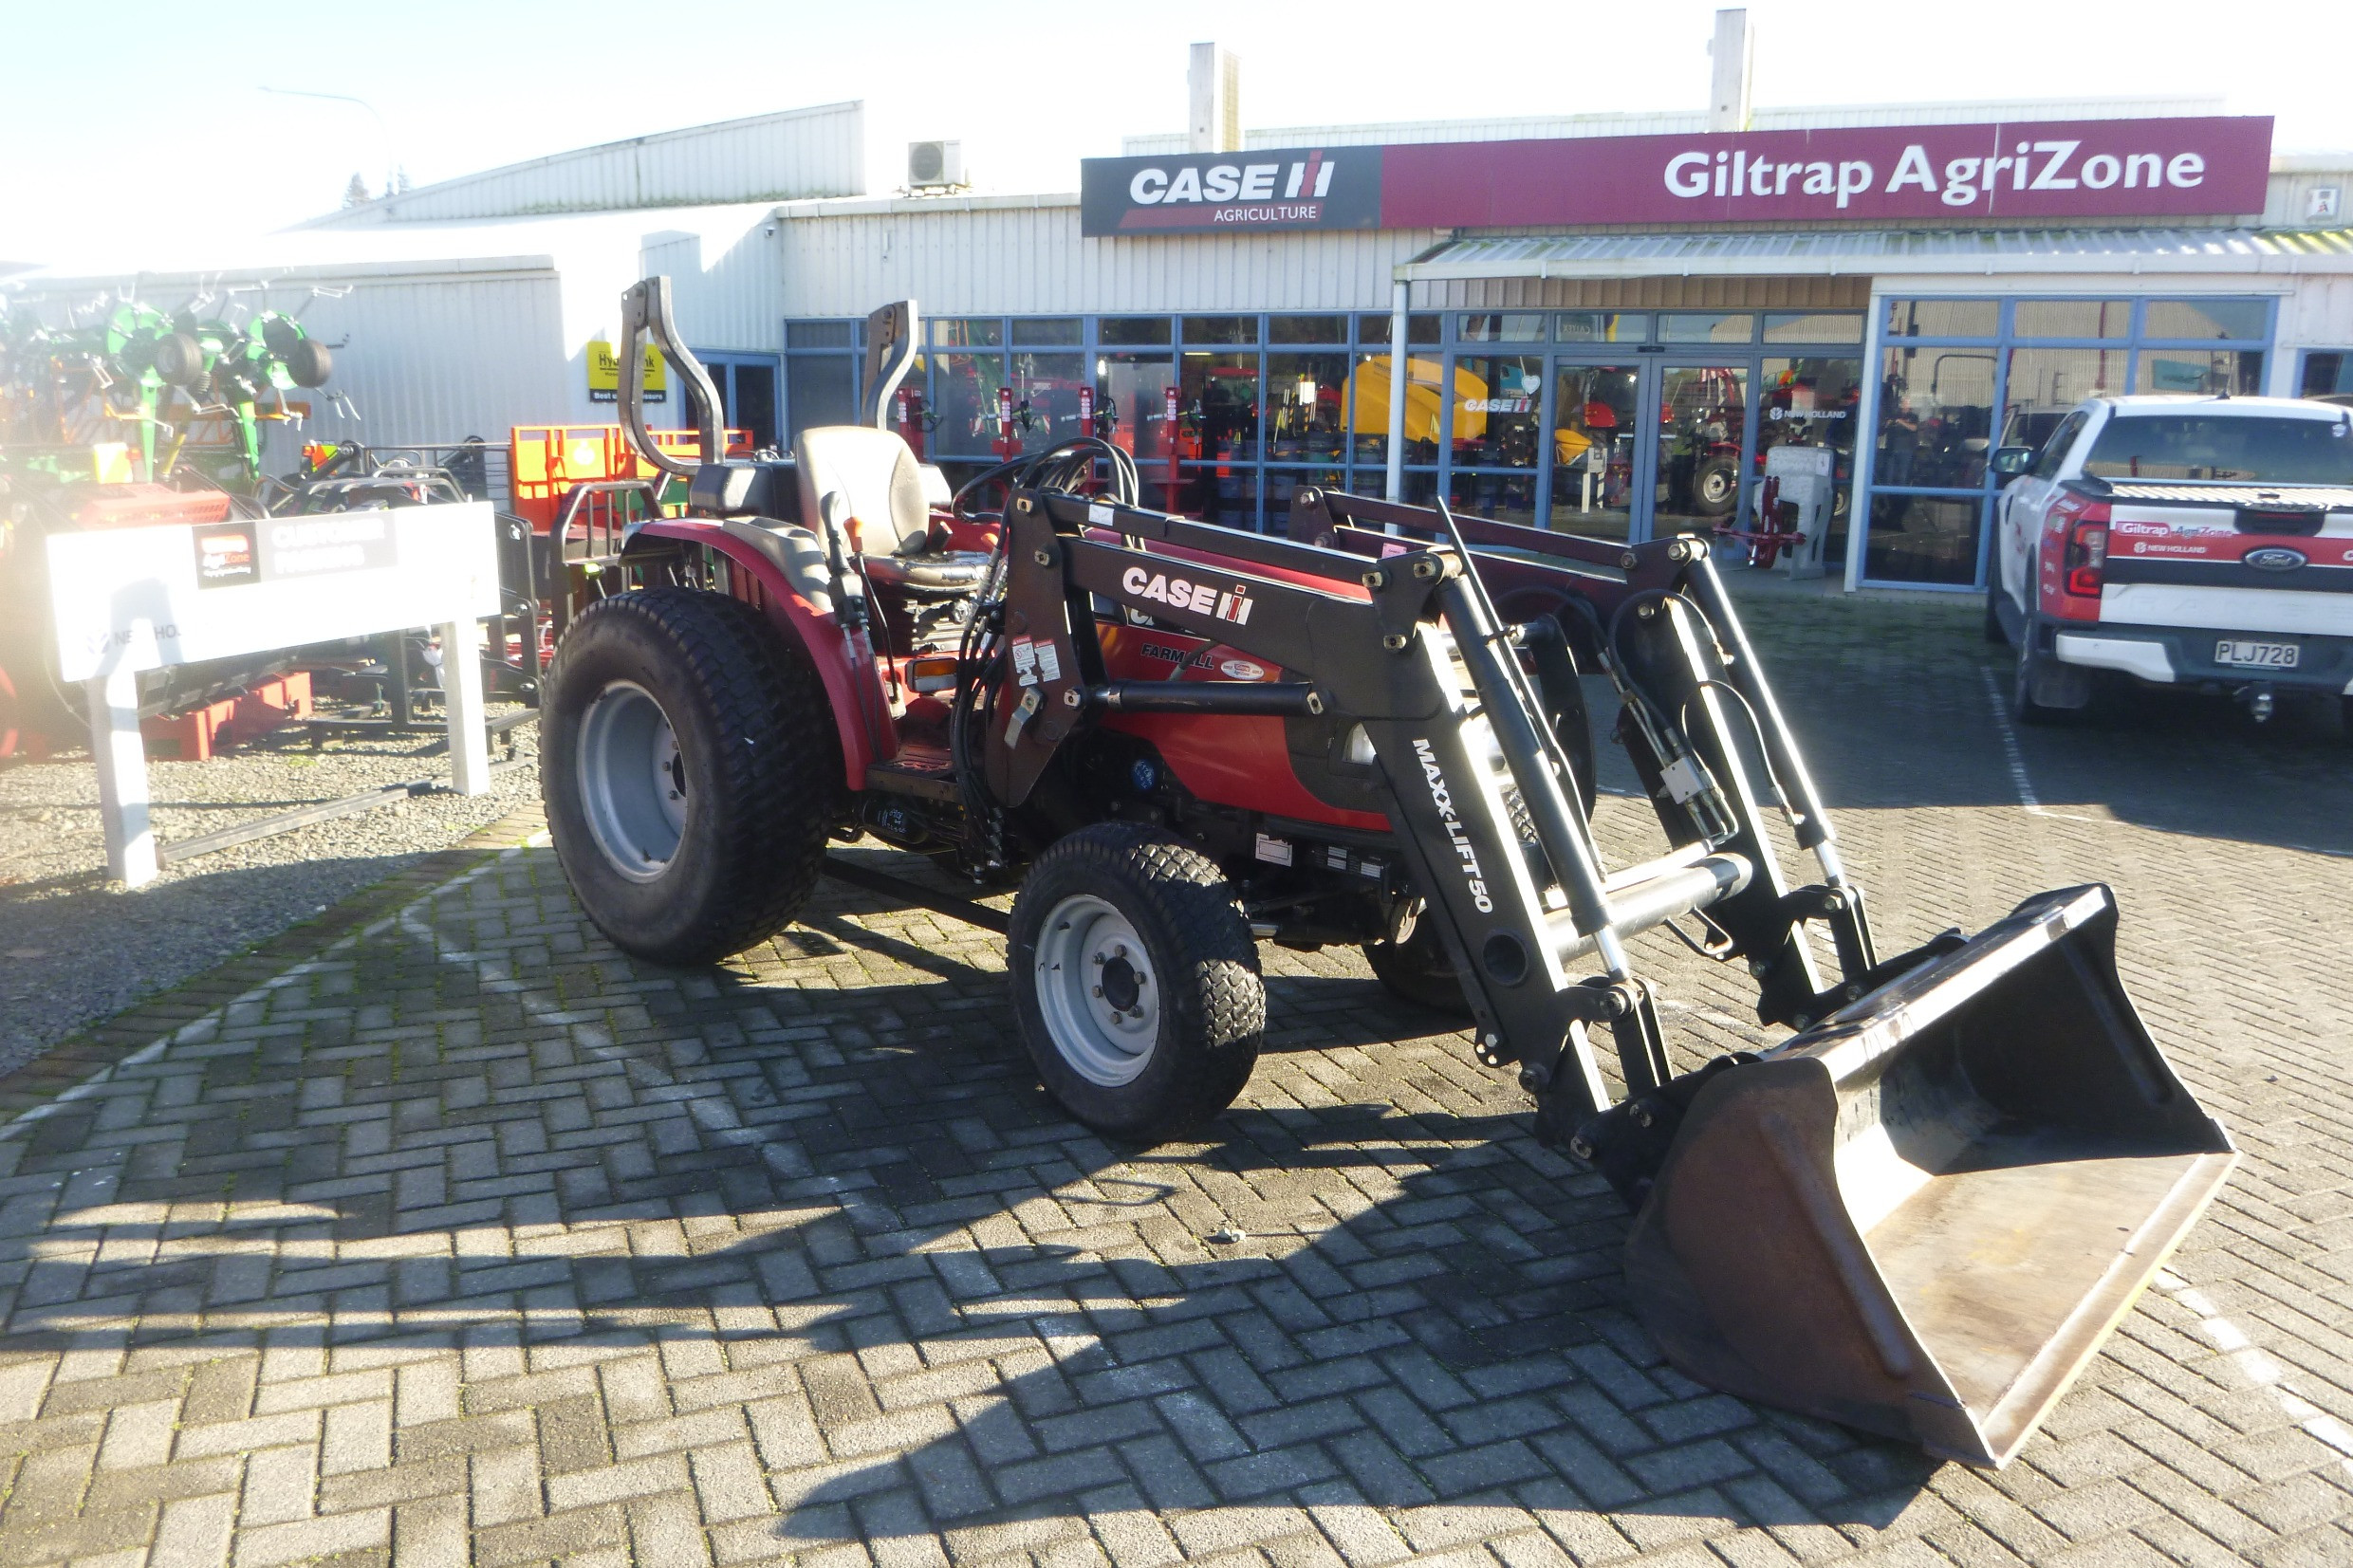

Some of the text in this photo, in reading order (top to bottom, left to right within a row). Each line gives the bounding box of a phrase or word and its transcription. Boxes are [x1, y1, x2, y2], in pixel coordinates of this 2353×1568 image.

[1130, 164, 1279, 205] CASE
[1663, 140, 2205, 209] Giltrap AgriZone
[1214, 206, 1317, 222] AGRICULTURE
[1464, 398, 1515, 412] CASE
[2121, 522, 2168, 536] Giltrap
[2147, 544, 2207, 554] NEW HOLLAND
[2260, 553, 2292, 566] Ford
[1122, 566, 1218, 616] CASE
[1140, 644, 1214, 670] FARMLL
[2217, 642, 2296, 666] PLJ728
[1412, 738, 1493, 913] MAXX-LIFT 50
